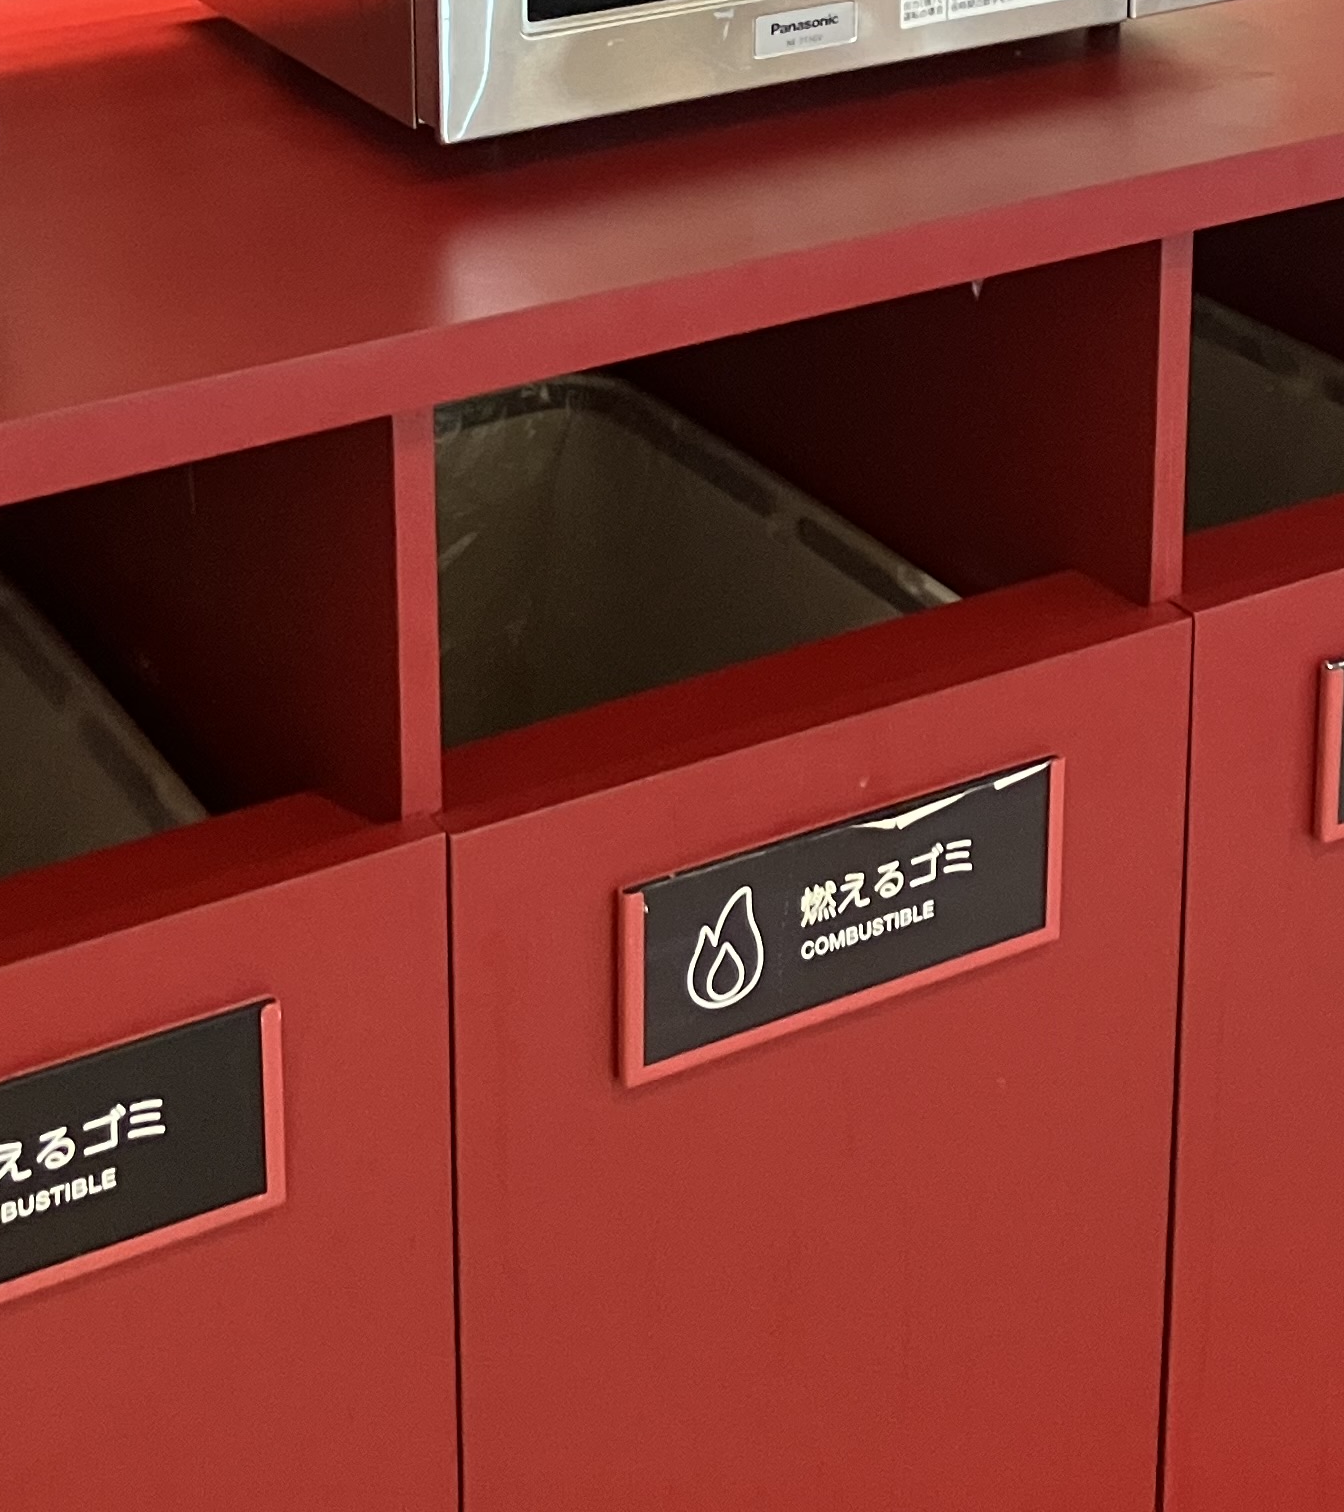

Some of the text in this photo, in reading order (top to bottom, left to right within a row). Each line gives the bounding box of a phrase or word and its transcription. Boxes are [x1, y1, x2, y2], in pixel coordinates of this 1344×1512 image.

[770, 13, 839, 36] Panasonic
[799, 838, 973, 928] 燃えるゴミ
[800, 899, 935, 961] COMBUSTIBLE
